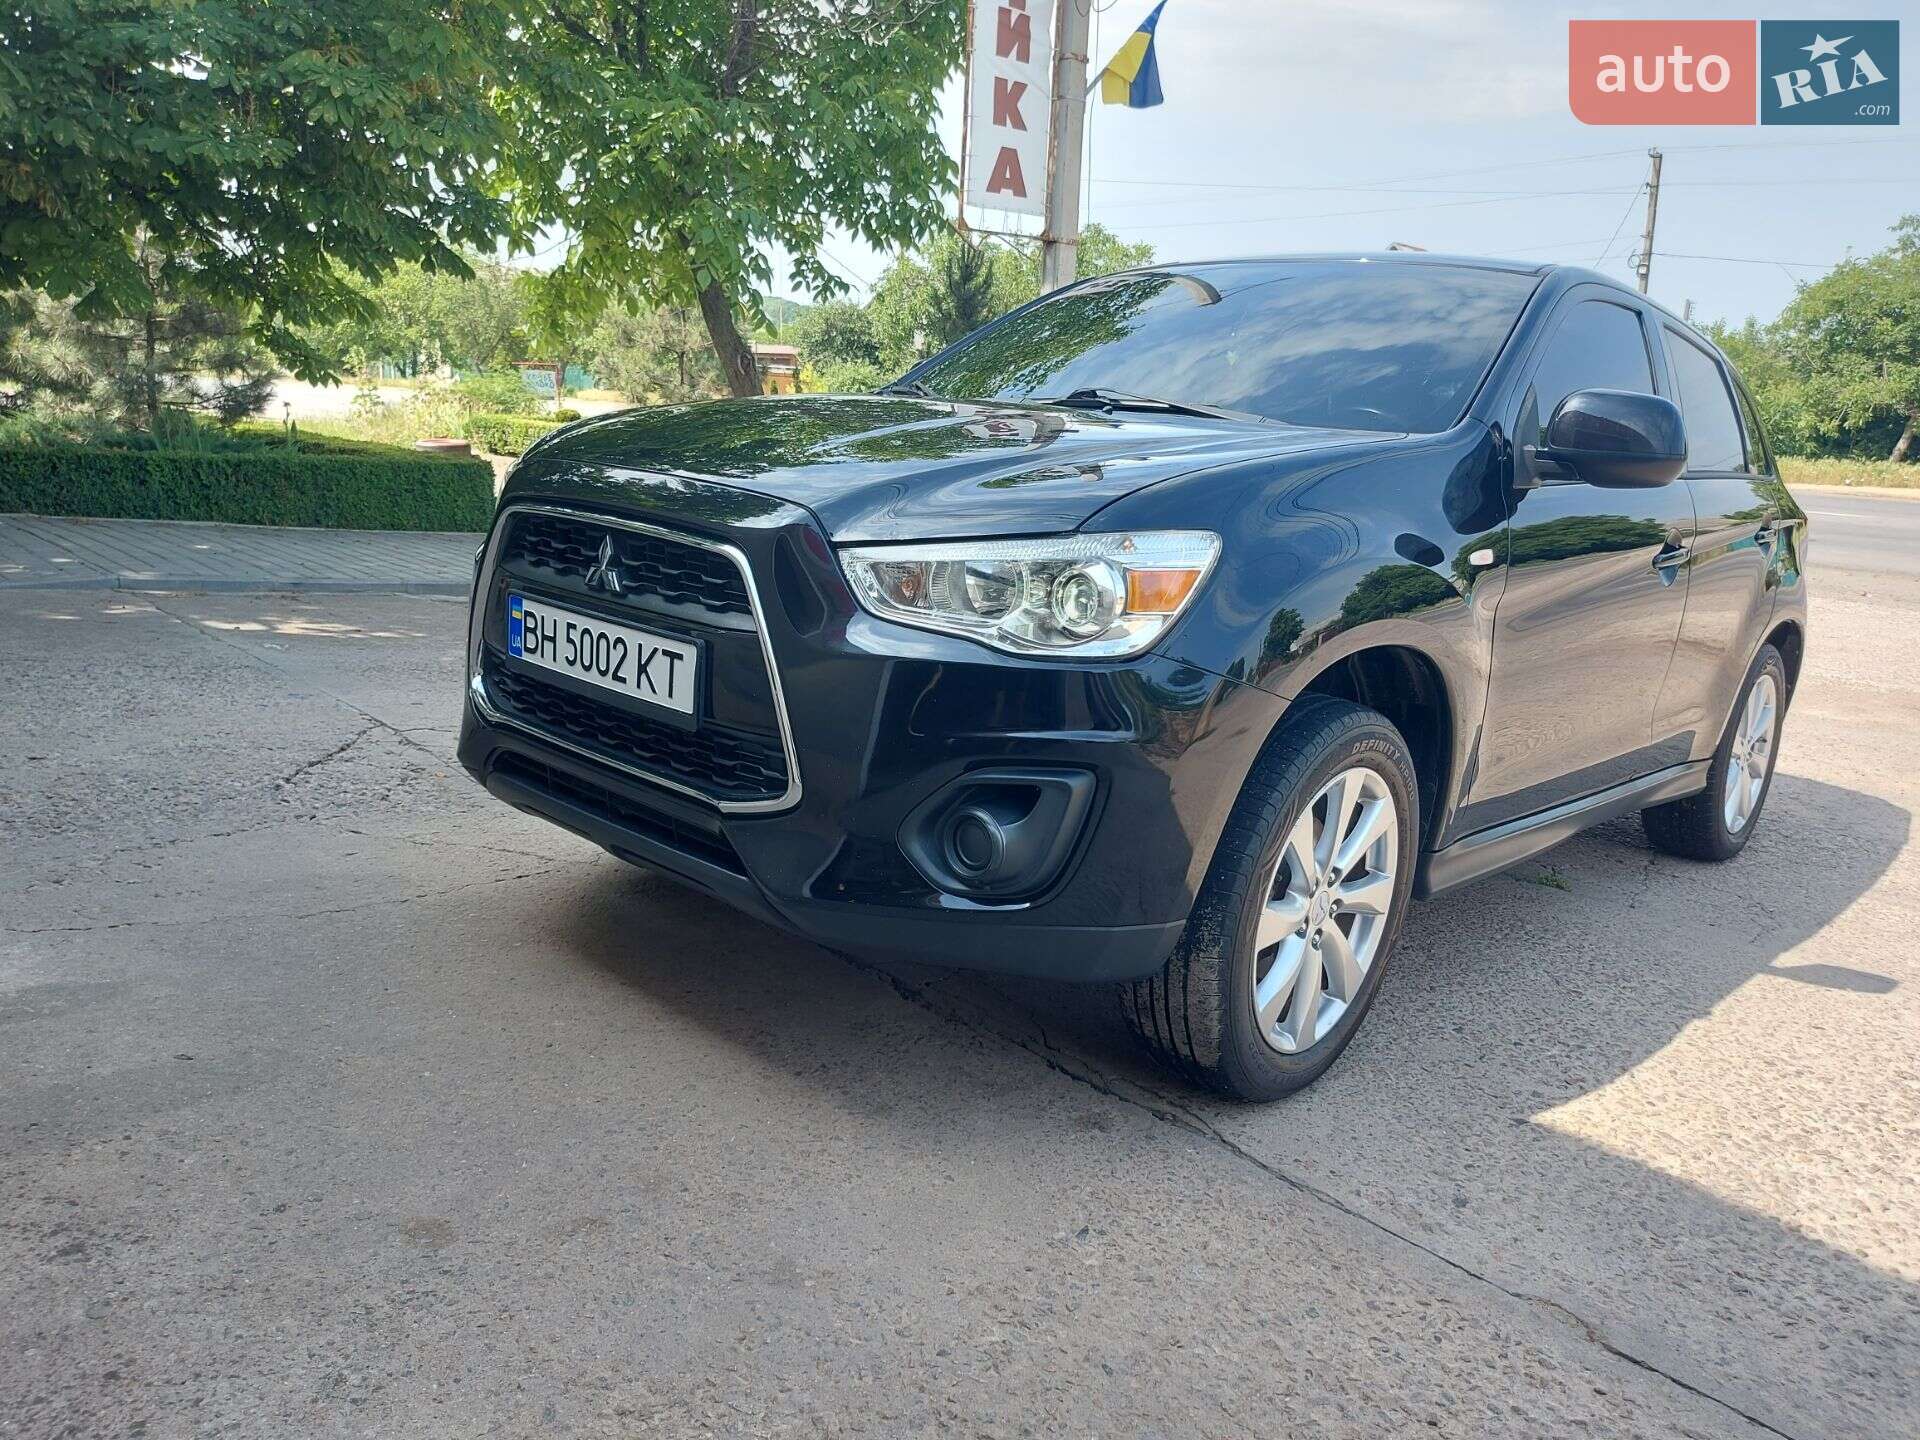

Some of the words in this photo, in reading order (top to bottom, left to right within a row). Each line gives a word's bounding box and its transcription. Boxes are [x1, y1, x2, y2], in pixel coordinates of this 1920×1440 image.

[511, 633, 522, 649] UA
[523, 608, 557, 662] BH
[565, 621, 628, 684] 5002
[637, 642, 684, 699] KT
[1352, 739, 1401, 761] DEFINITY
